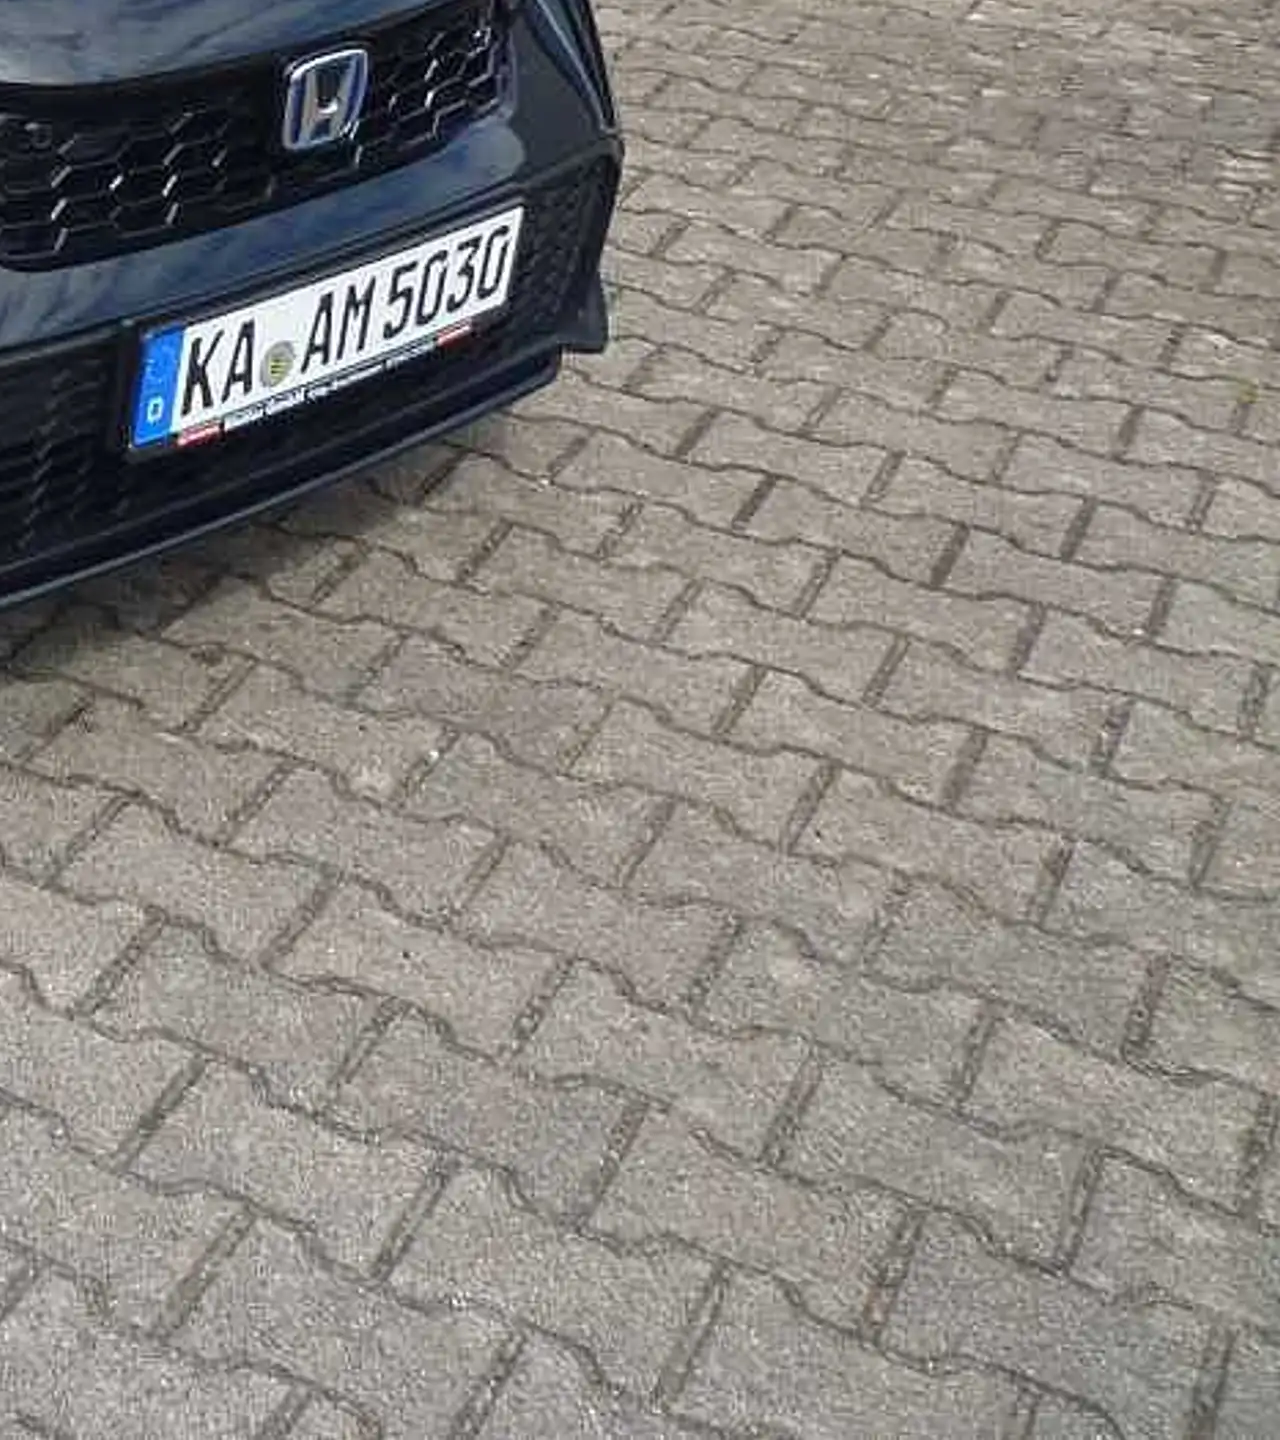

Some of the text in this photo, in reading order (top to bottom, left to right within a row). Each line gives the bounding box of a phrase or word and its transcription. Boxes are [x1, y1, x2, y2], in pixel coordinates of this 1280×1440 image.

[180, 317, 256, 417] KA
[300, 275, 376, 374] AM
[382, 224, 511, 339] 5030
